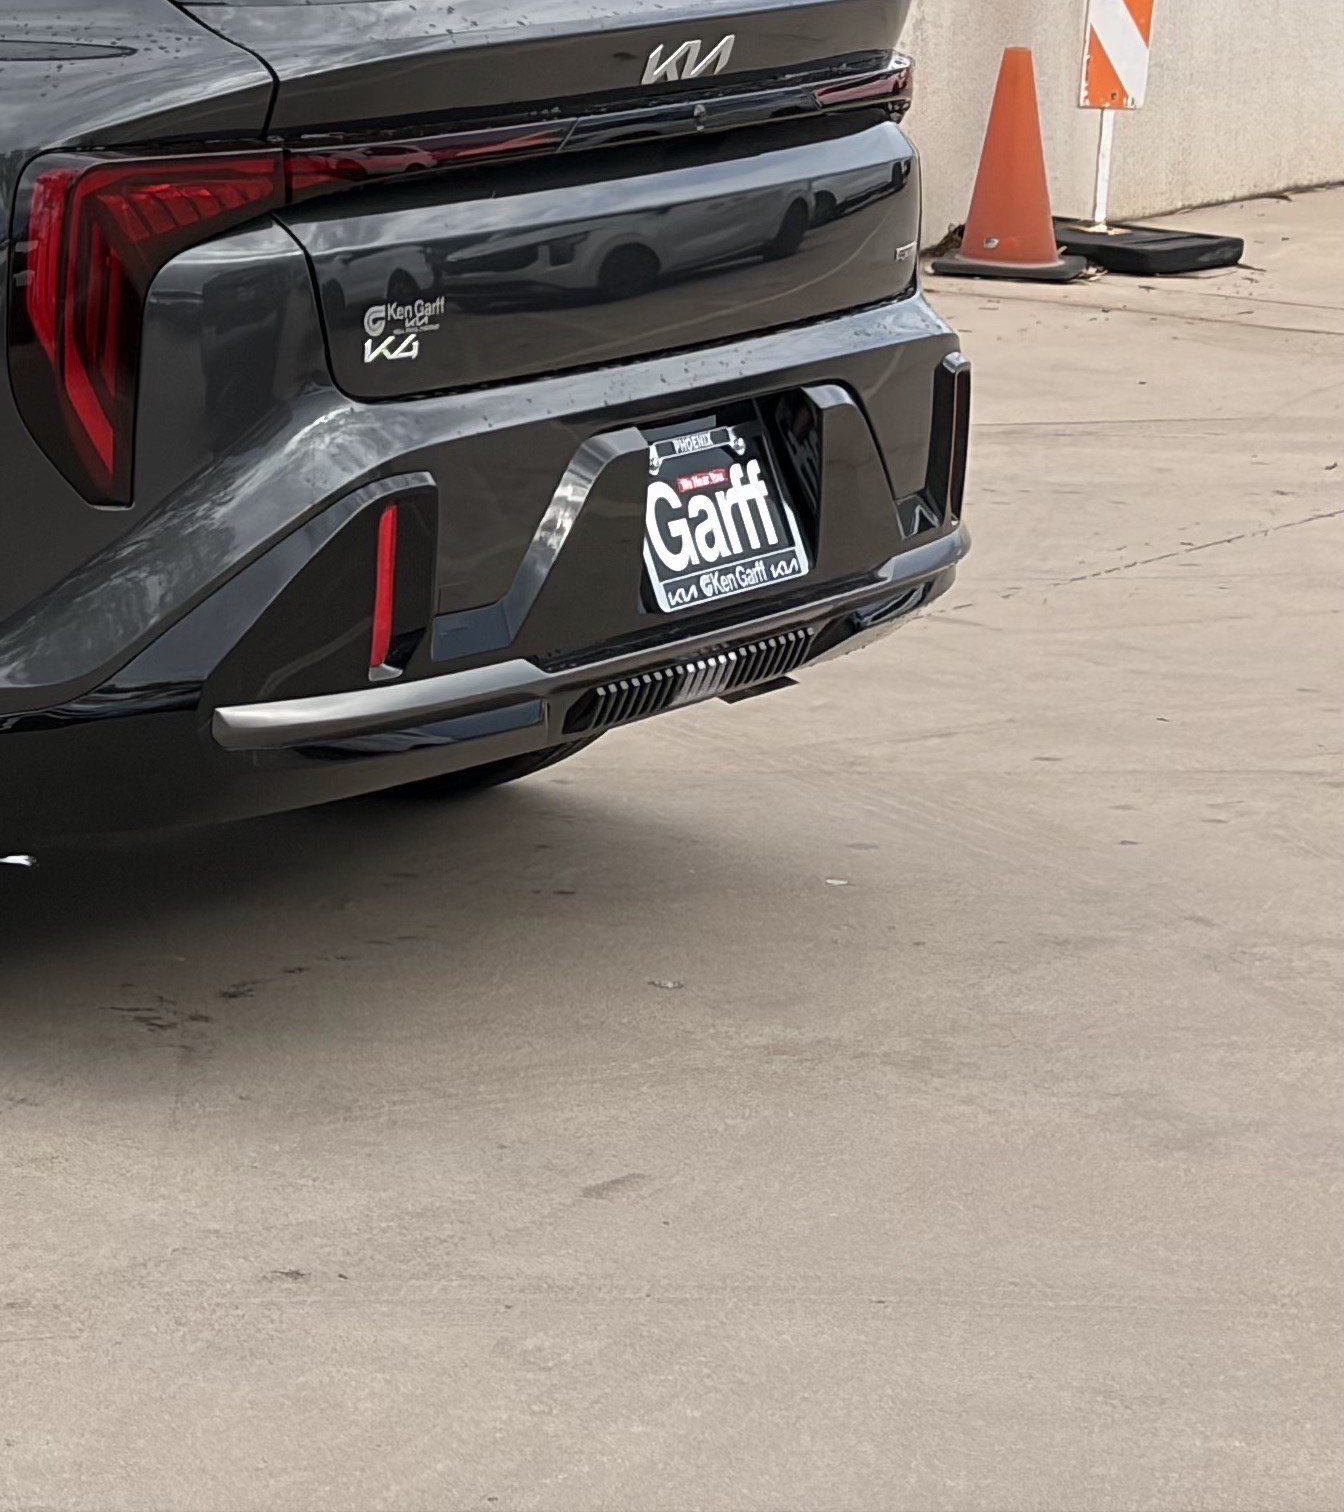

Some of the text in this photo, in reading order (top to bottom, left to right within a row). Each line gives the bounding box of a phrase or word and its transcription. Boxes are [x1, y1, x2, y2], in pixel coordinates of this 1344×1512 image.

[641, 34, 735, 86] KIA
[387, 302, 413, 321] Ken
[413, 296, 445, 317] Garff
[364, 334, 419, 363] K4
[673, 431, 714, 455] PHOENIX
[645, 459, 779, 572] Garff
[668, 584, 698, 605] KIA
[770, 557, 799, 578] KIA
